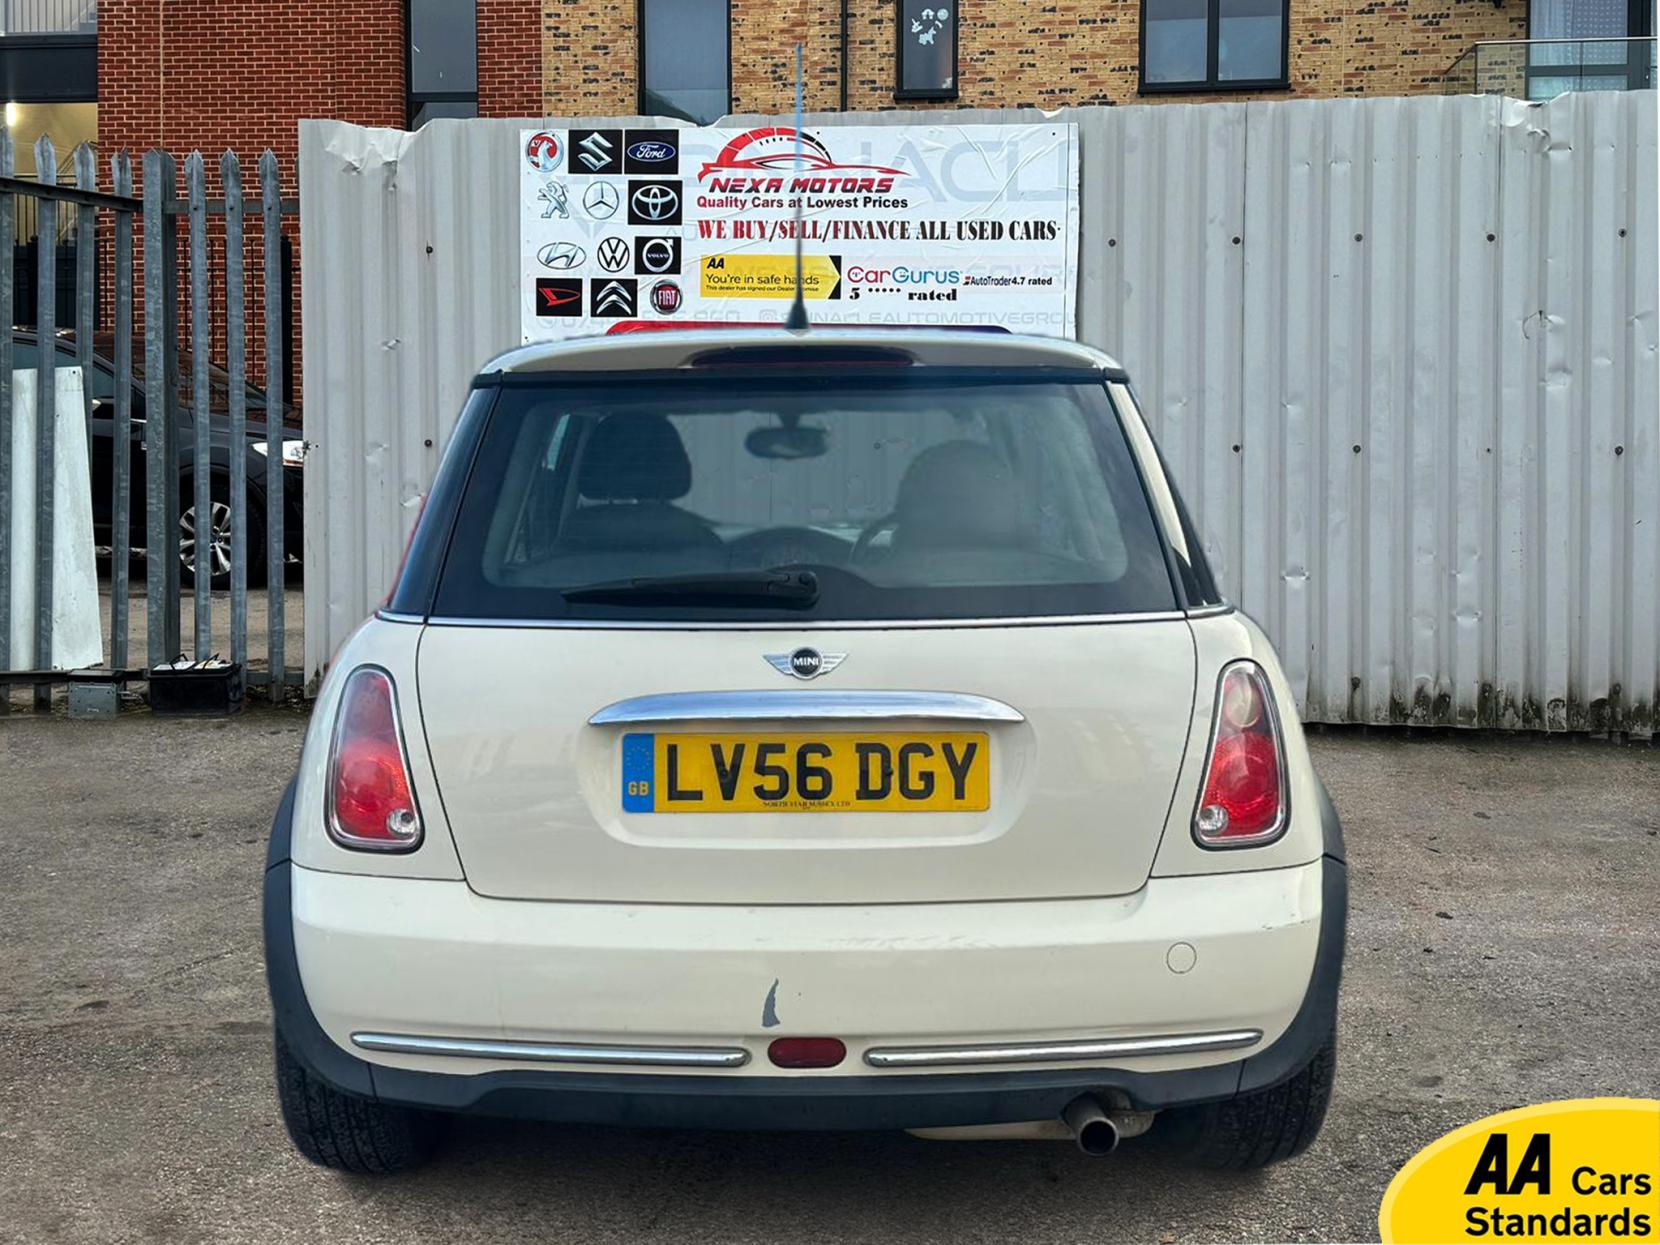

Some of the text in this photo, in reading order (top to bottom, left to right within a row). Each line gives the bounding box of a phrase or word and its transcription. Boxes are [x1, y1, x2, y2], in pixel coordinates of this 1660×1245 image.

[636, 144, 666, 159] Ford
[708, 178, 895, 194] NEXA MOTORS
[697, 196, 908, 210] Quality Cars at Lowest Prices
[698, 220, 727, 240] WE
[916, 220, 951, 240] ALL
[956, 220, 1004, 241] USED
[706, 258, 725, 269] AA
[705, 273, 741, 284] You're
[744, 274, 754, 284] in
[757, 274, 781, 285] safe
[848, 266, 960, 284] CarGurus
[1027, 277, 1053, 286] rated
[658, 290, 676, 306] FIAT
[849, 287, 957, 301] 5 rated
[793, 657, 819, 666] MINI
[667, 743, 978, 801] LV56 DGY
[628, 782, 649, 796] GB
